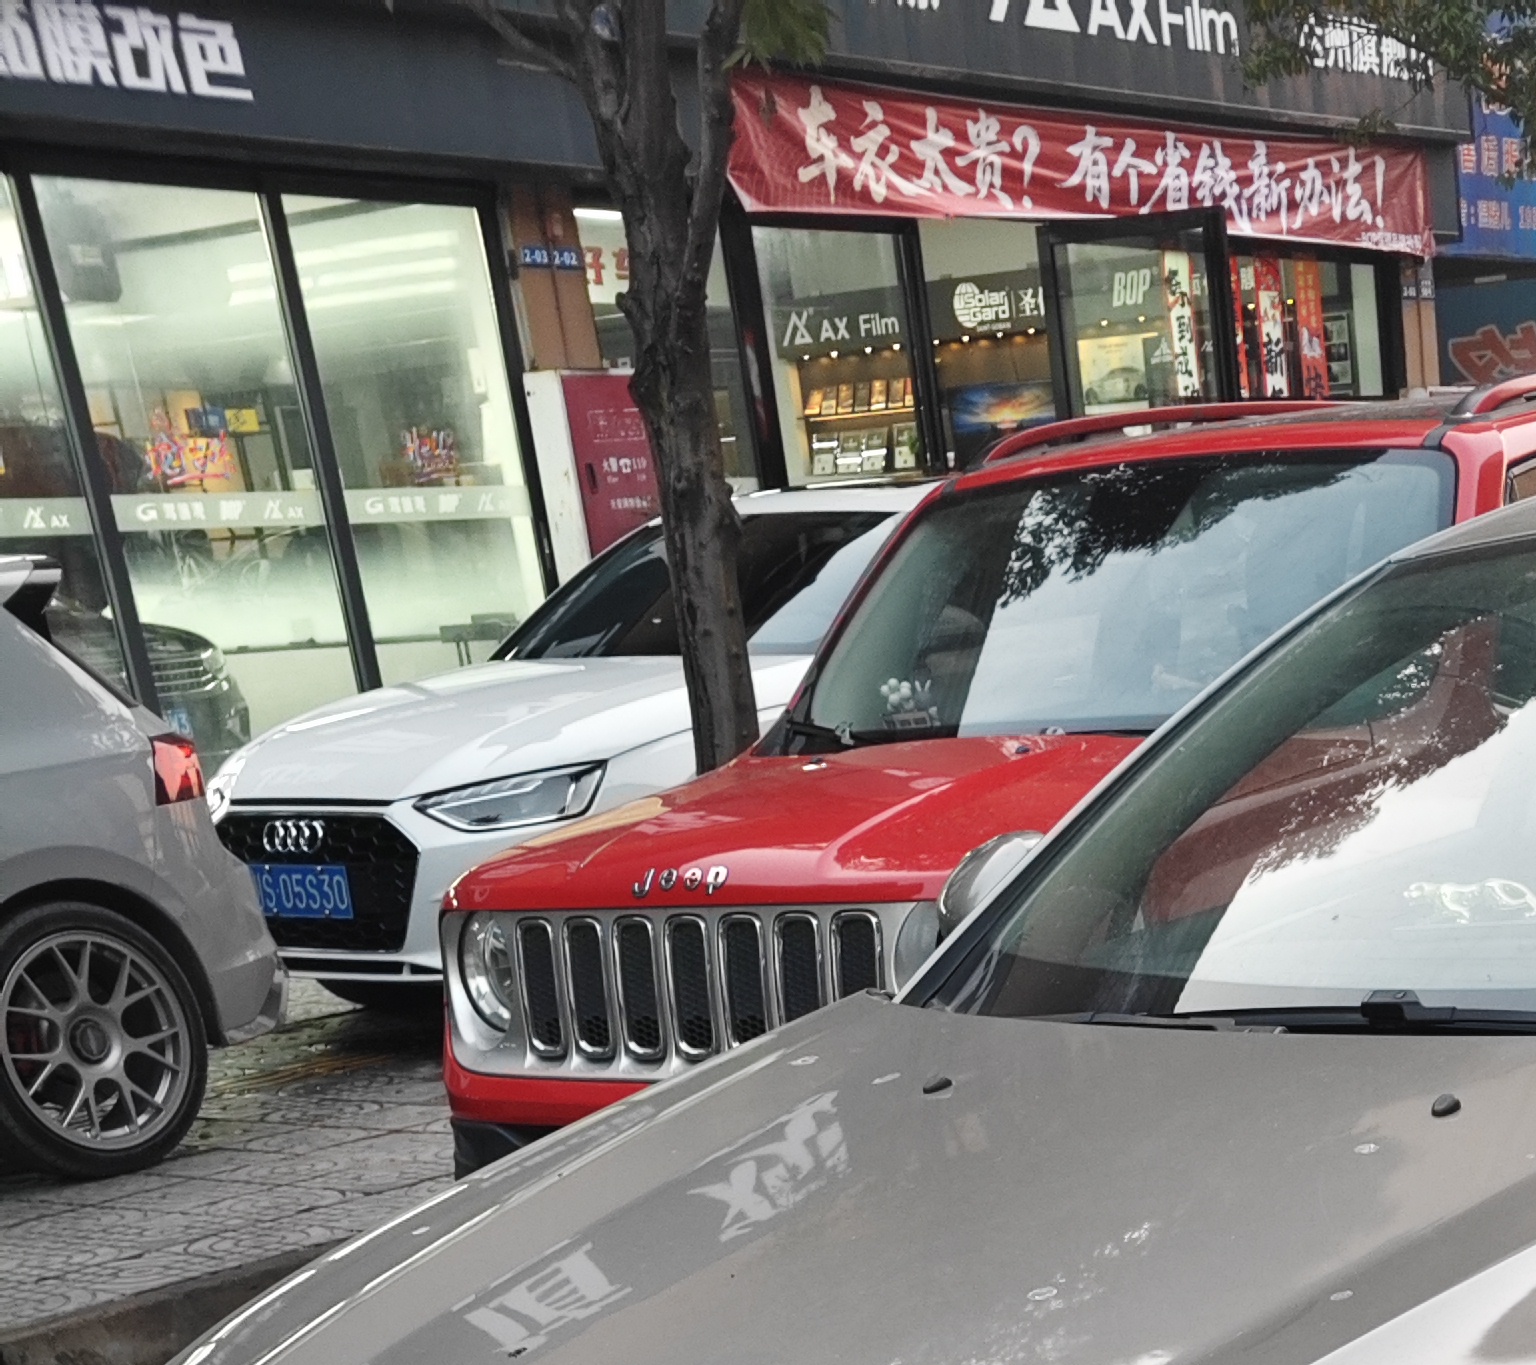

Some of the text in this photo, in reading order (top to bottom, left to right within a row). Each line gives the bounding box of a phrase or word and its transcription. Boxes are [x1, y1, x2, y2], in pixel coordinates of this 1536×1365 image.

[964, 289, 1006, 307] Solar
[1112, 268, 1151, 307] BOP
[970, 298, 1009, 321] Gard
[820, 312, 900, 342] AX Film
[256, 872, 348, 910] S·05S30
[631, 863, 731, 898] Jeep
